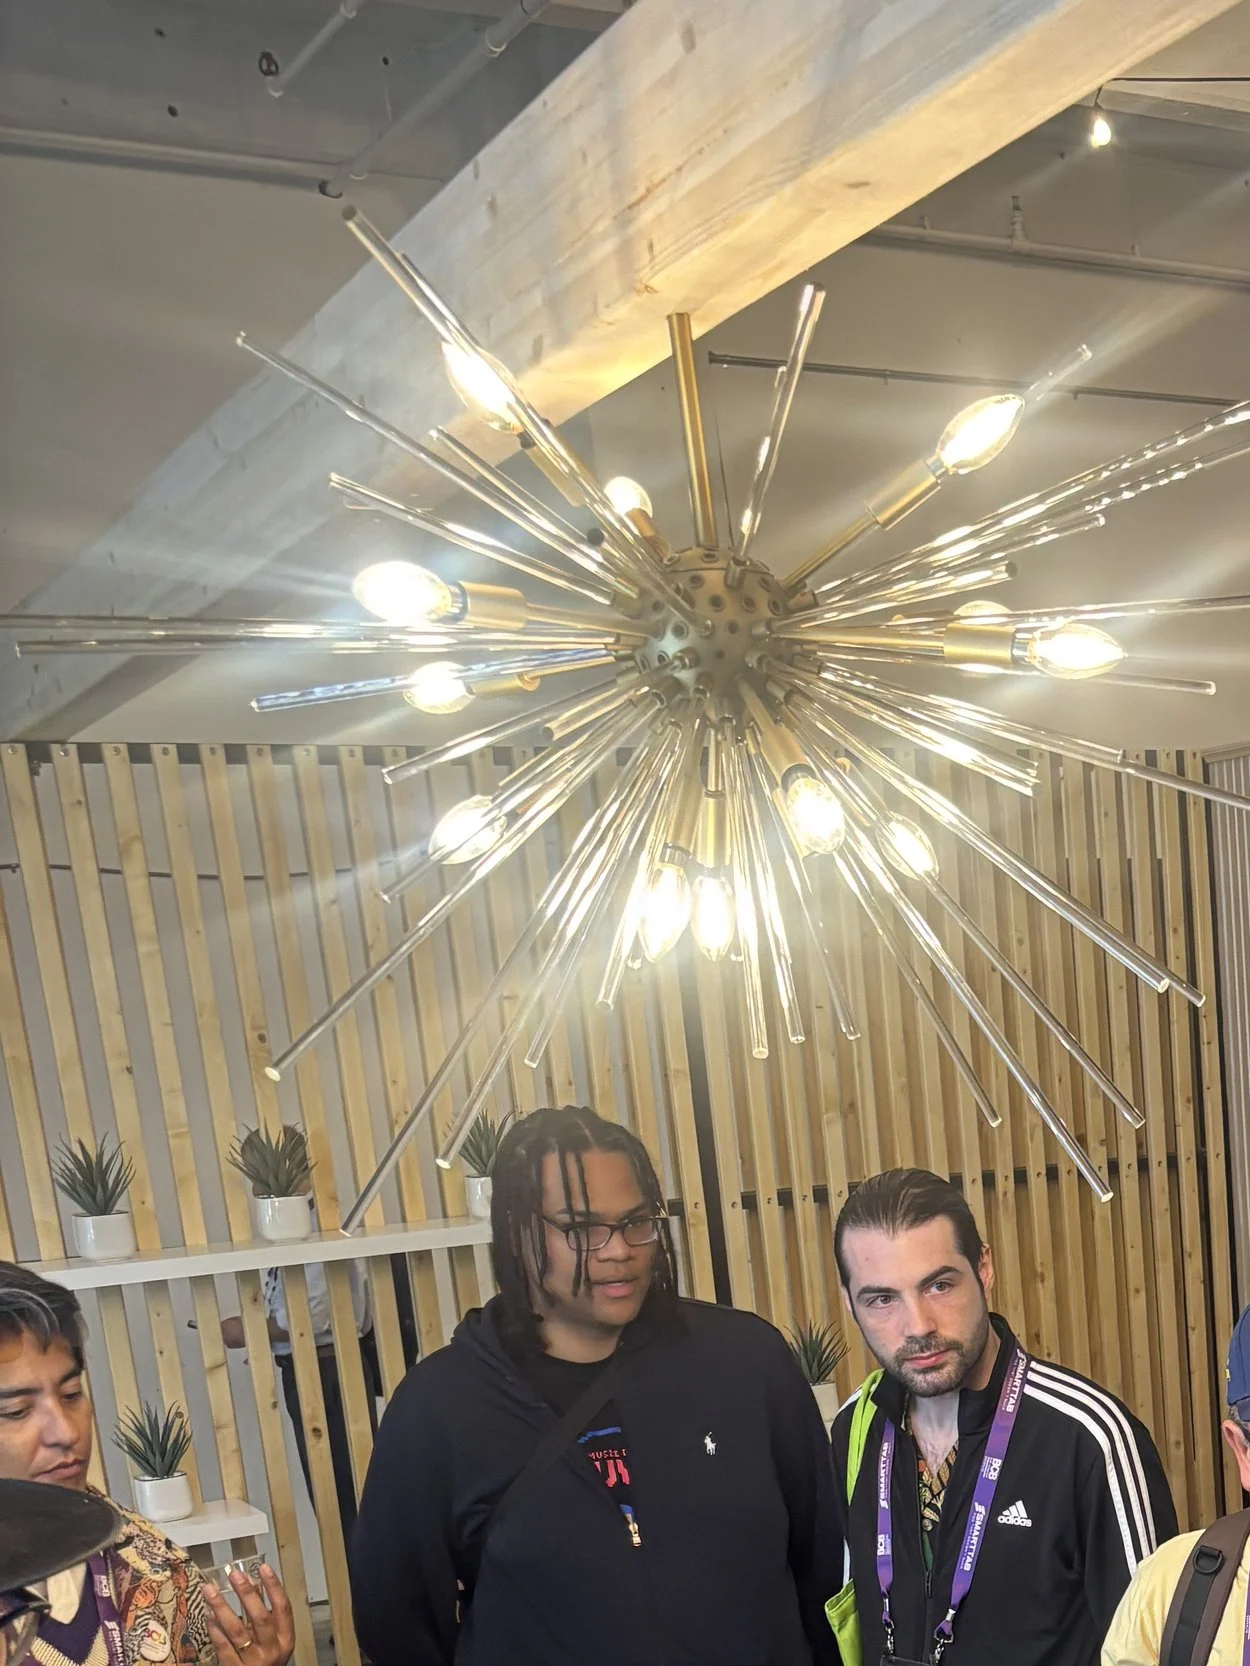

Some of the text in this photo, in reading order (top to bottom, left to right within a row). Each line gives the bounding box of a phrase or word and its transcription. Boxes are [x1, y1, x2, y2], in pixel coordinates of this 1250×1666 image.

[1006, 1360, 1028, 1413] SMARTTAB
[880, 1442, 889, 1500] SMARTTAB
[988, 1458, 1002, 1481] BCB
[998, 1515, 1032, 1527] adidas
[877, 1534, 885, 1556] BCB
[963, 1514, 984, 1571] SMARTTAB
